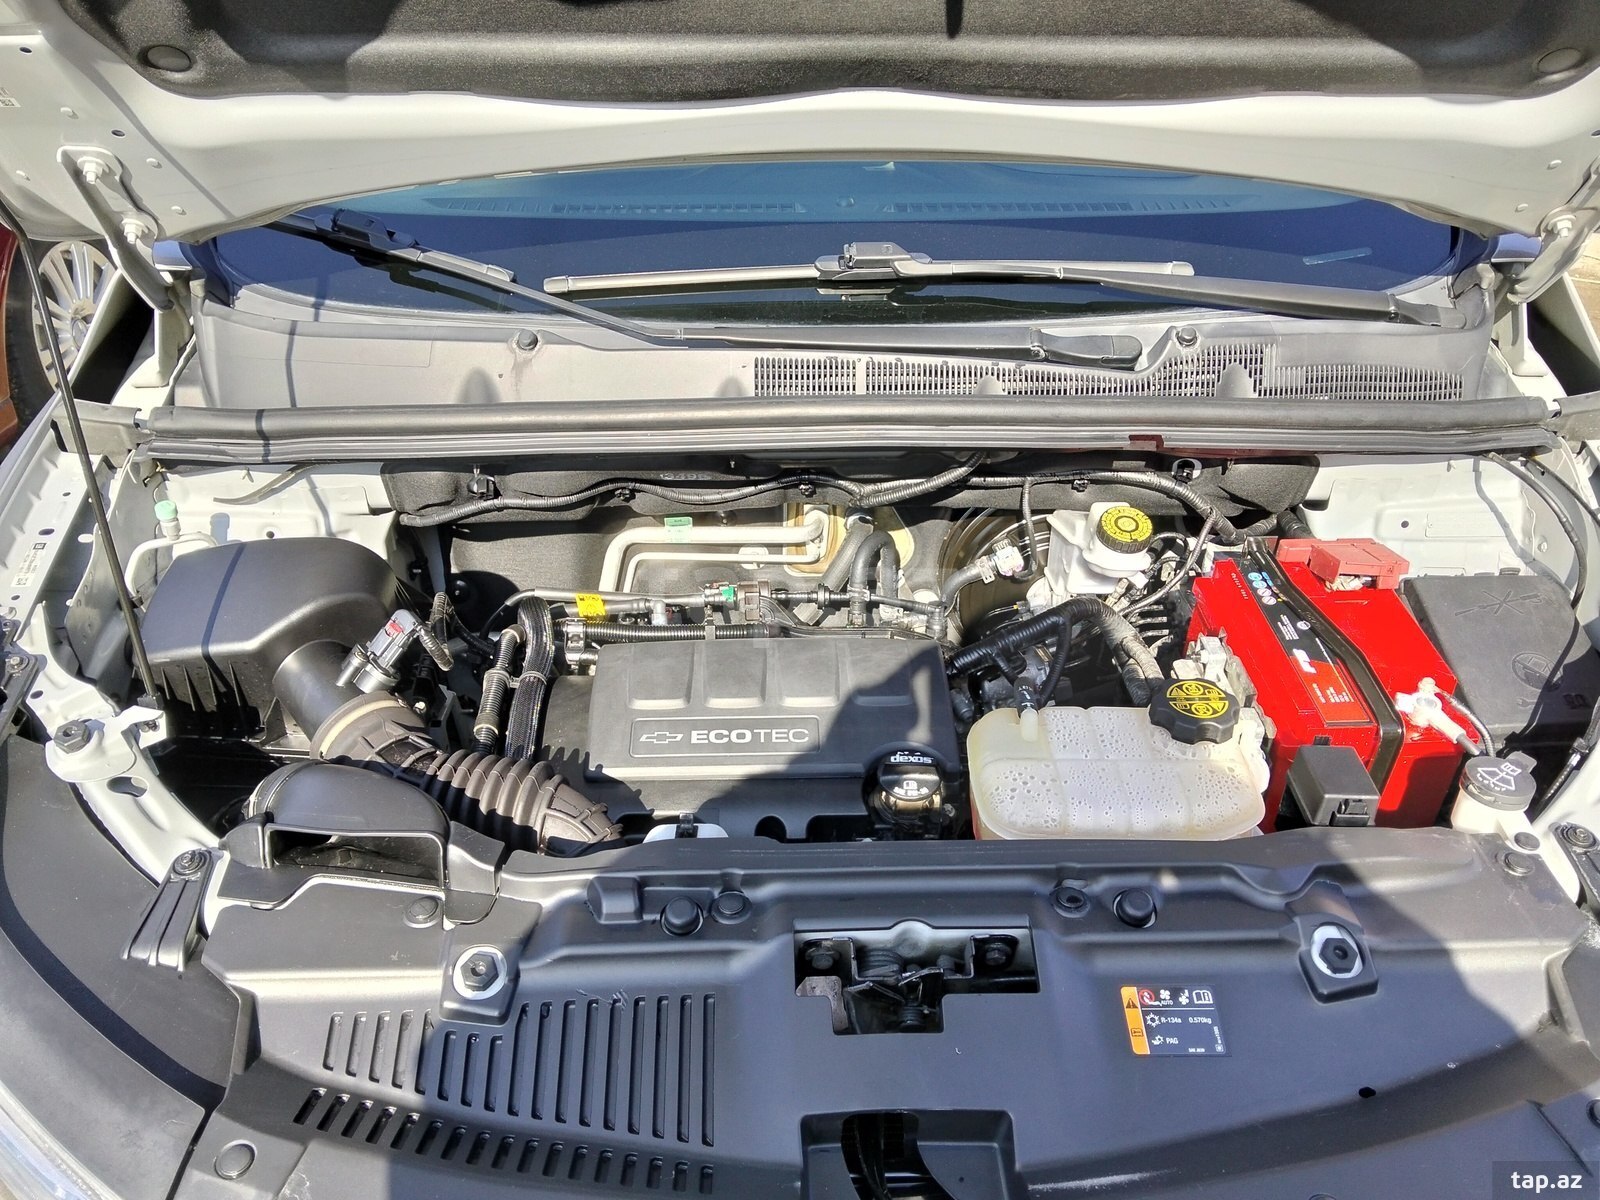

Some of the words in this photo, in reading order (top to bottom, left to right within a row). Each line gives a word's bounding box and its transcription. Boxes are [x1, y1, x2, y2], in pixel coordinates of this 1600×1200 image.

[690, 728, 810, 744] ECOTEC
[890, 753, 933, 764] dexos
[1160, 1016, 1182, 1024] R-134a
[1188, 1016, 1212, 1025] 0.570kg
[1166, 1037, 1179, 1045] PAG
